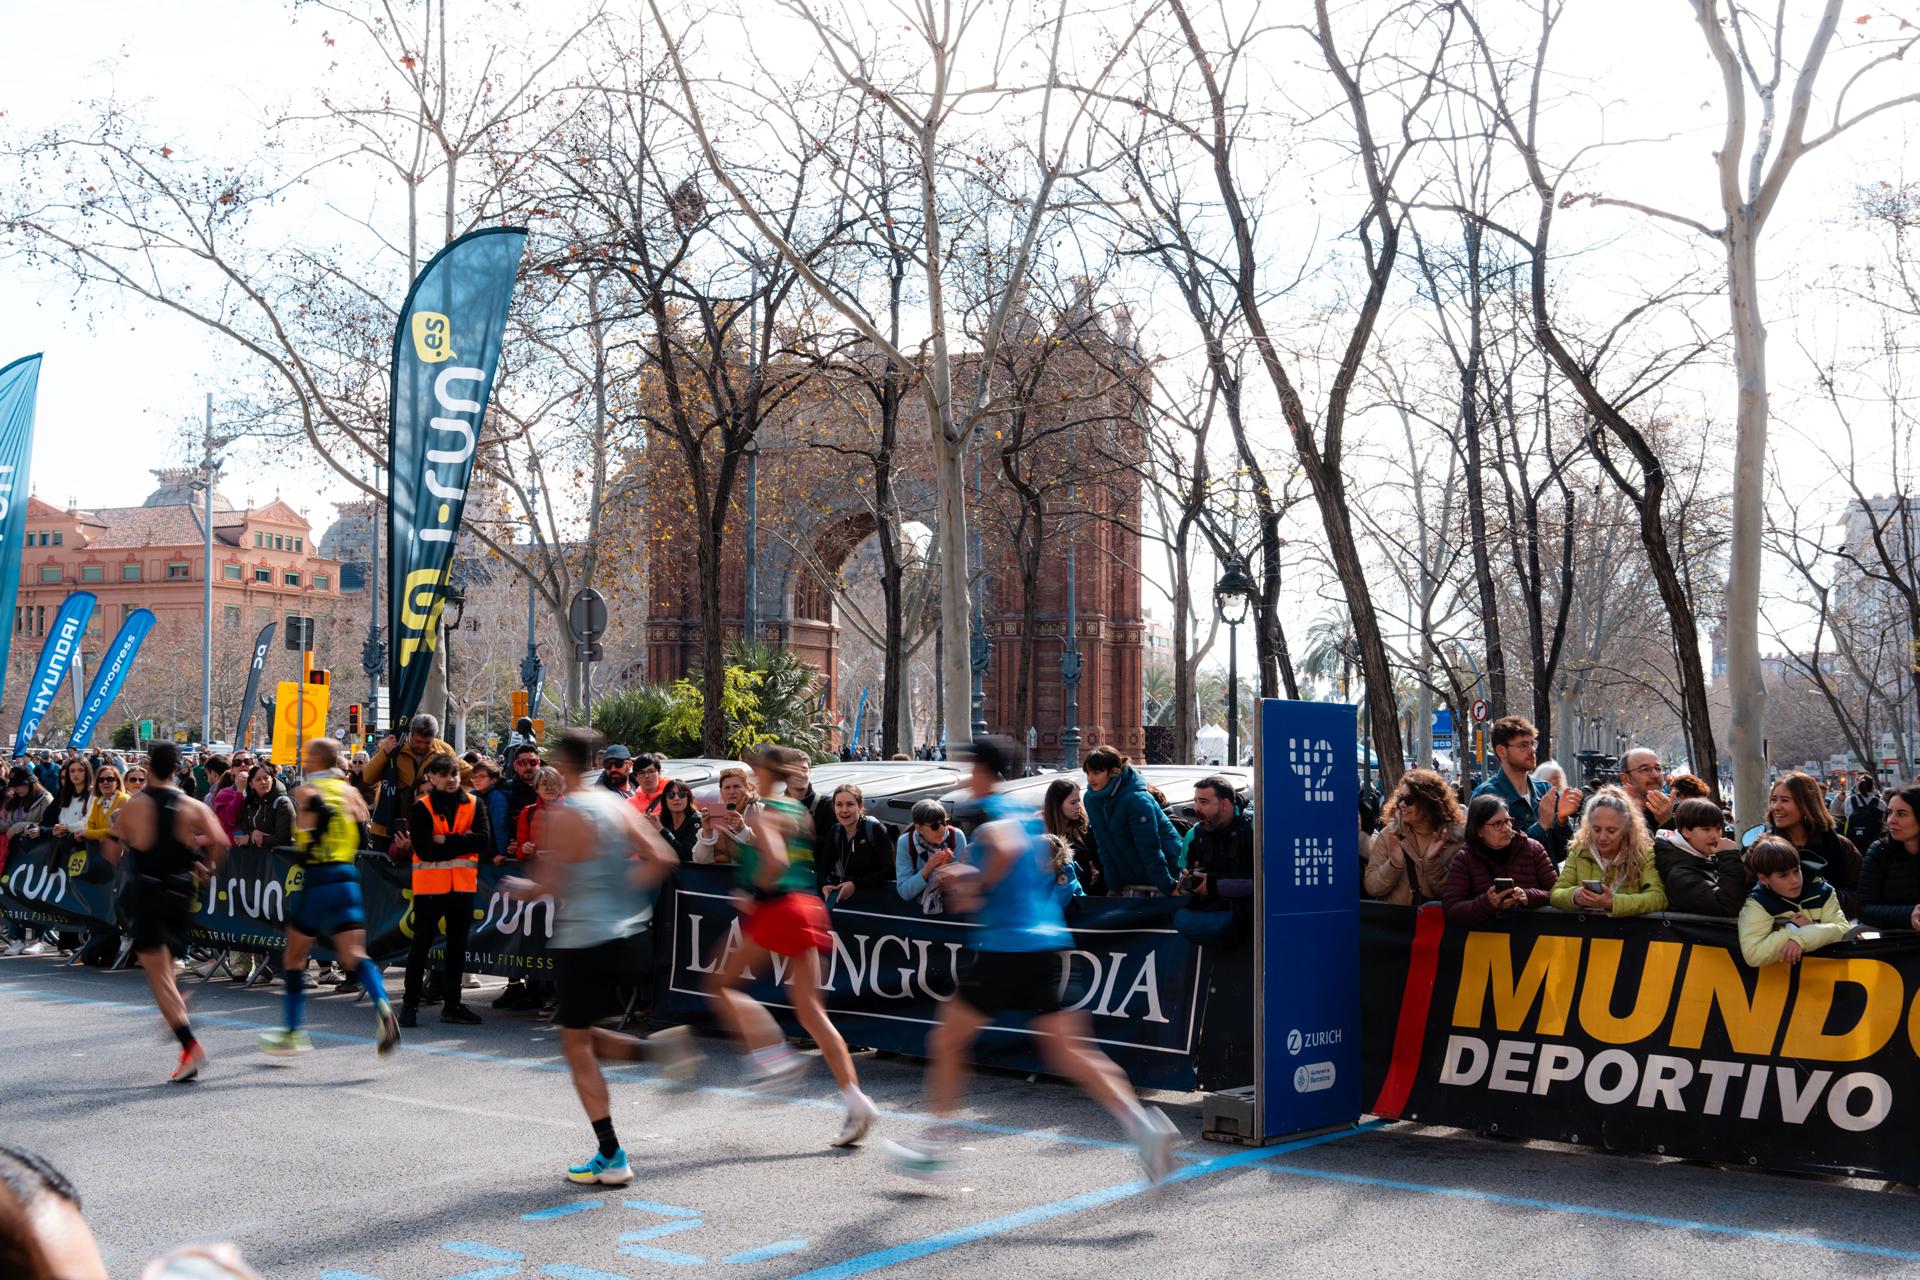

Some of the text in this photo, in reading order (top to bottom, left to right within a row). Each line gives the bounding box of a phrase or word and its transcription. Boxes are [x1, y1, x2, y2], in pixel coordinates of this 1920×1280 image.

[423, 317, 445, 358] .es
[32, 617, 80, 715] HYUNDAI
[73, 634, 136, 743] Run to progress
[1289, 738, 1334, 802] 42
[207, 930, 237, 943] TRAIL
[240, 933, 288, 947] FITNESS
[464, 951, 554, 970] RAIL FITNESS
[1304, 1028, 1342, 1048] ZURICH
[1438, 1034, 1893, 1132] DEPORTIVO
